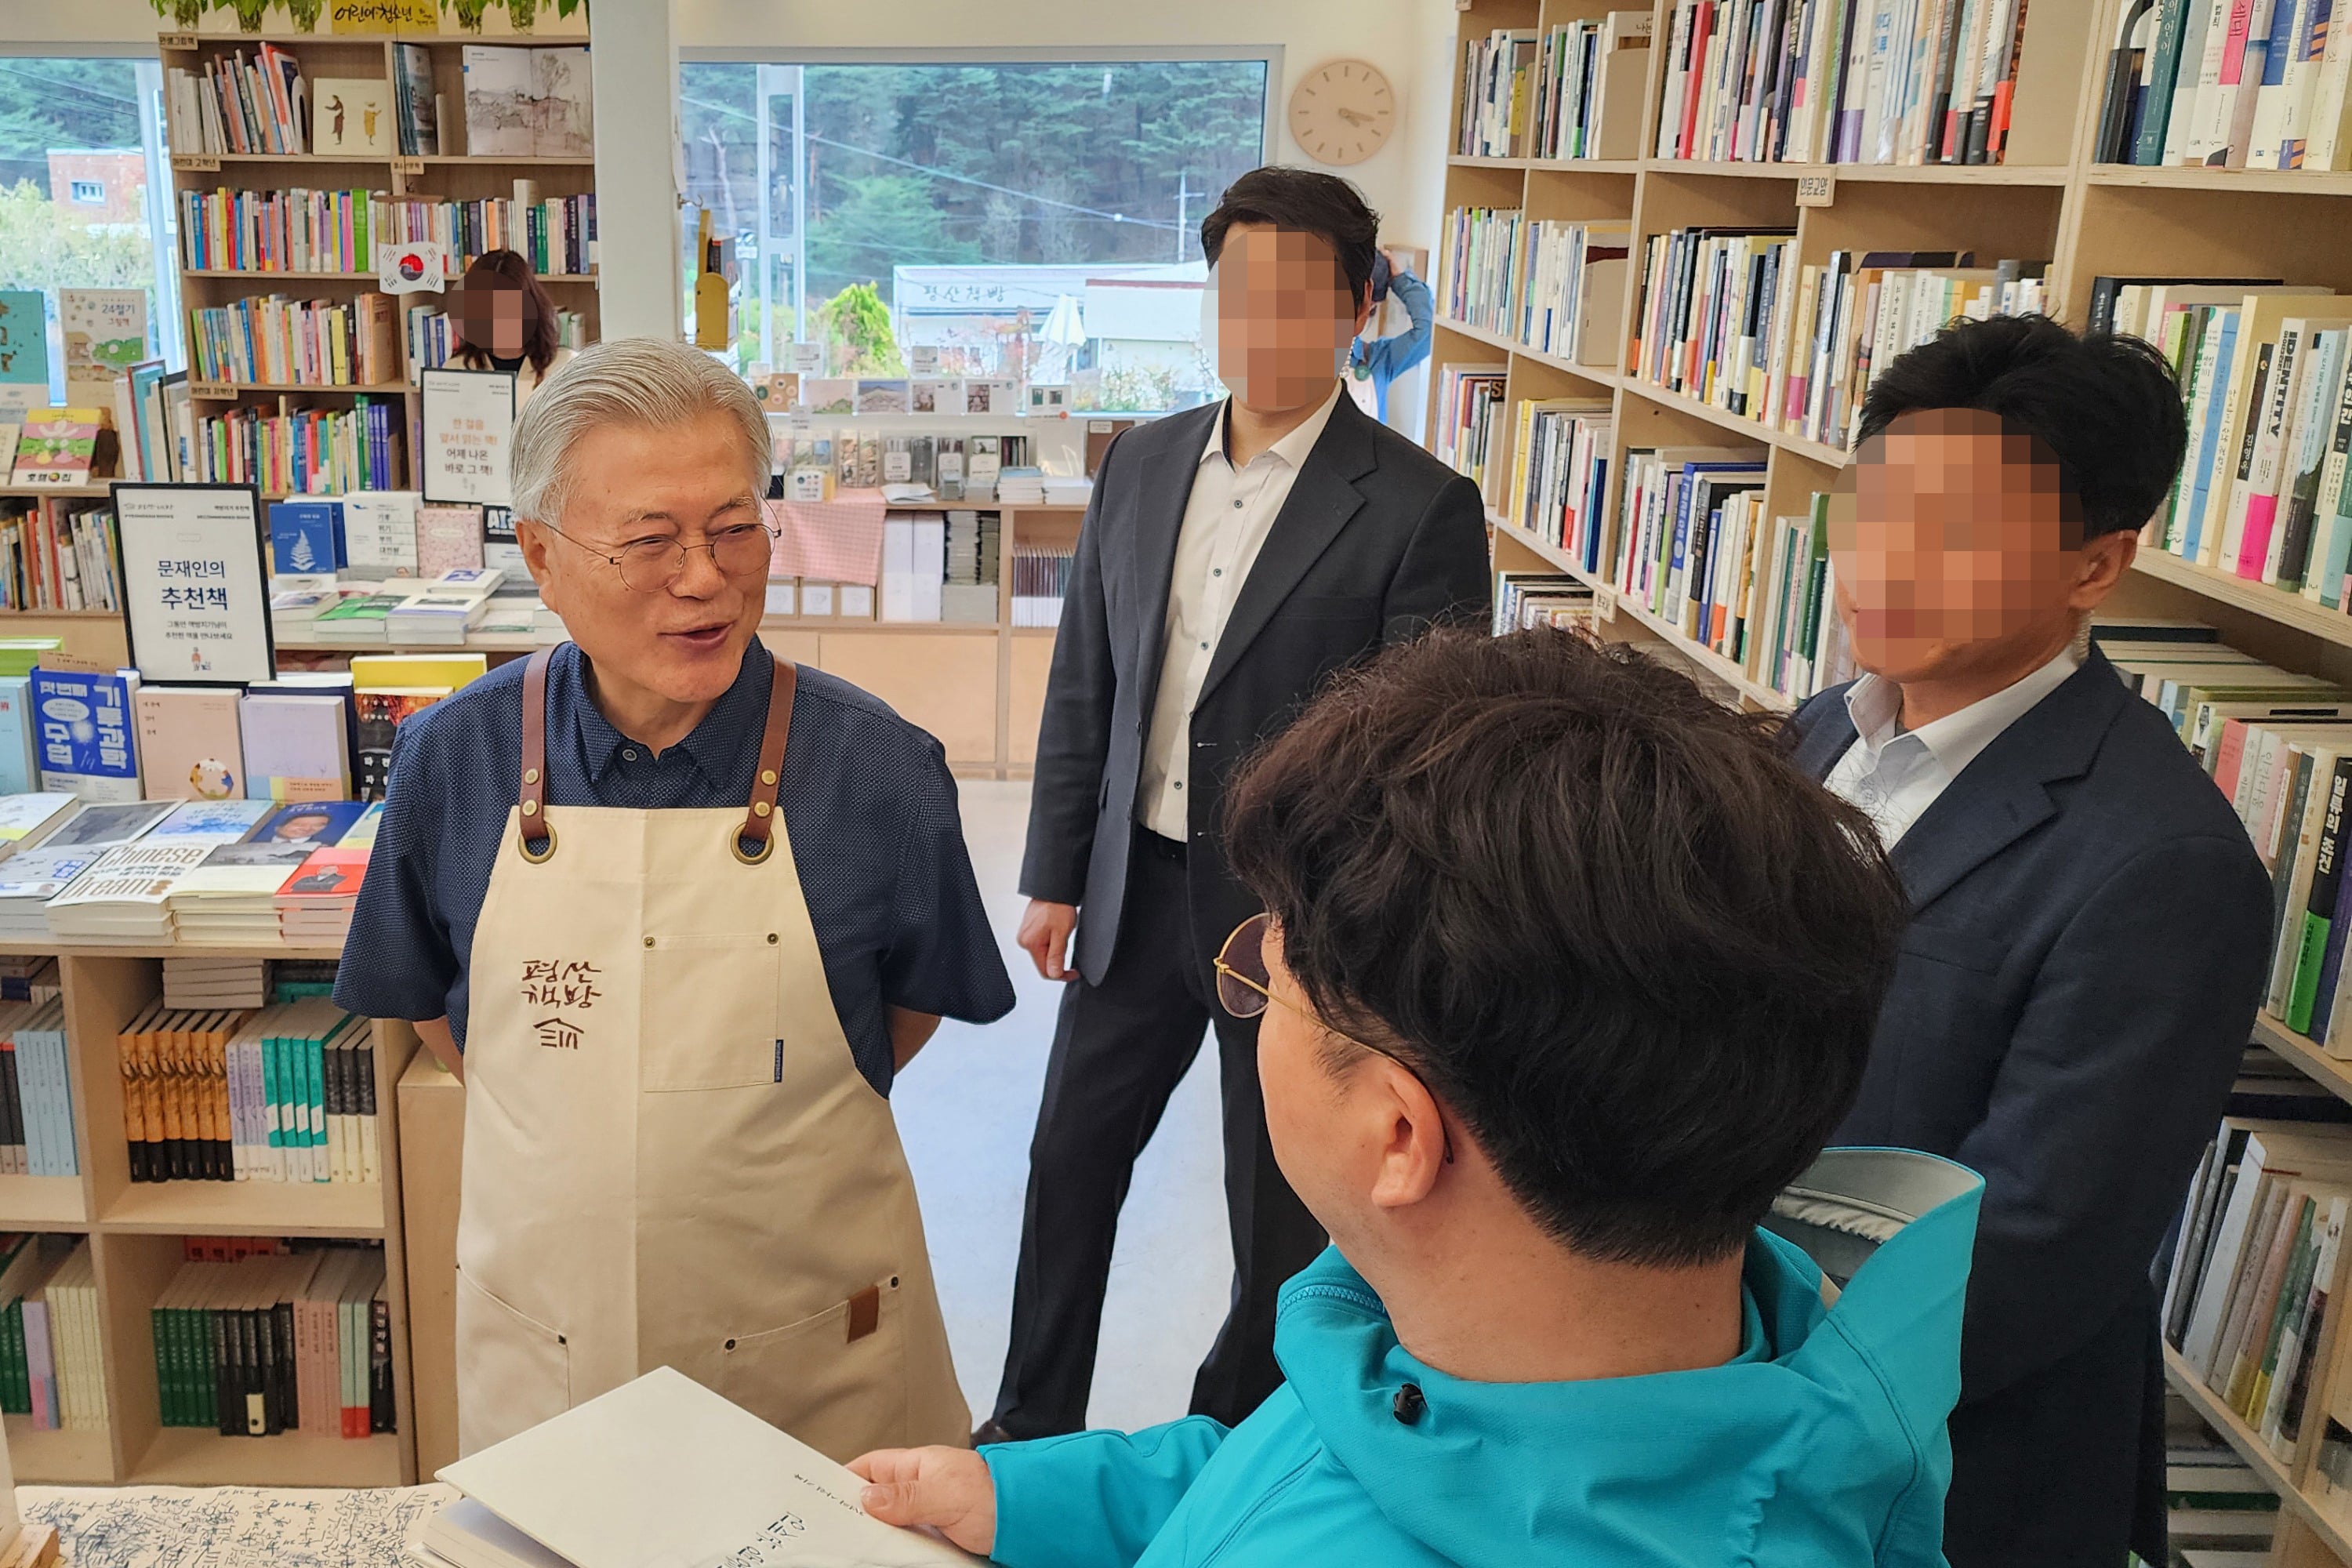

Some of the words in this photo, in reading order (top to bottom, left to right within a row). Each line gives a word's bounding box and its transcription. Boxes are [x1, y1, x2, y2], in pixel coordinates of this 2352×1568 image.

[1800, 177, 1828, 196] 인문교양
[923, 285, 1004, 303] 평산책방
[101, 303, 135, 315] 24절기
[2270, 331, 2298, 438] IDENTITY
[446, 449, 466, 459] 어제
[469, 450, 488, 461] 나온
[445, 463, 464, 474] 바로
[467, 465, 477, 474] 그
[158, 561, 225, 579] 문재인의
[162, 587, 227, 610] 추천책
[44, 722, 73, 765] 수업
[97, 843, 204, 868] Chinese
[60, 877, 155, 900] Dream
[521, 960, 602, 983] 평산
[521, 984, 603, 1009] 책방
